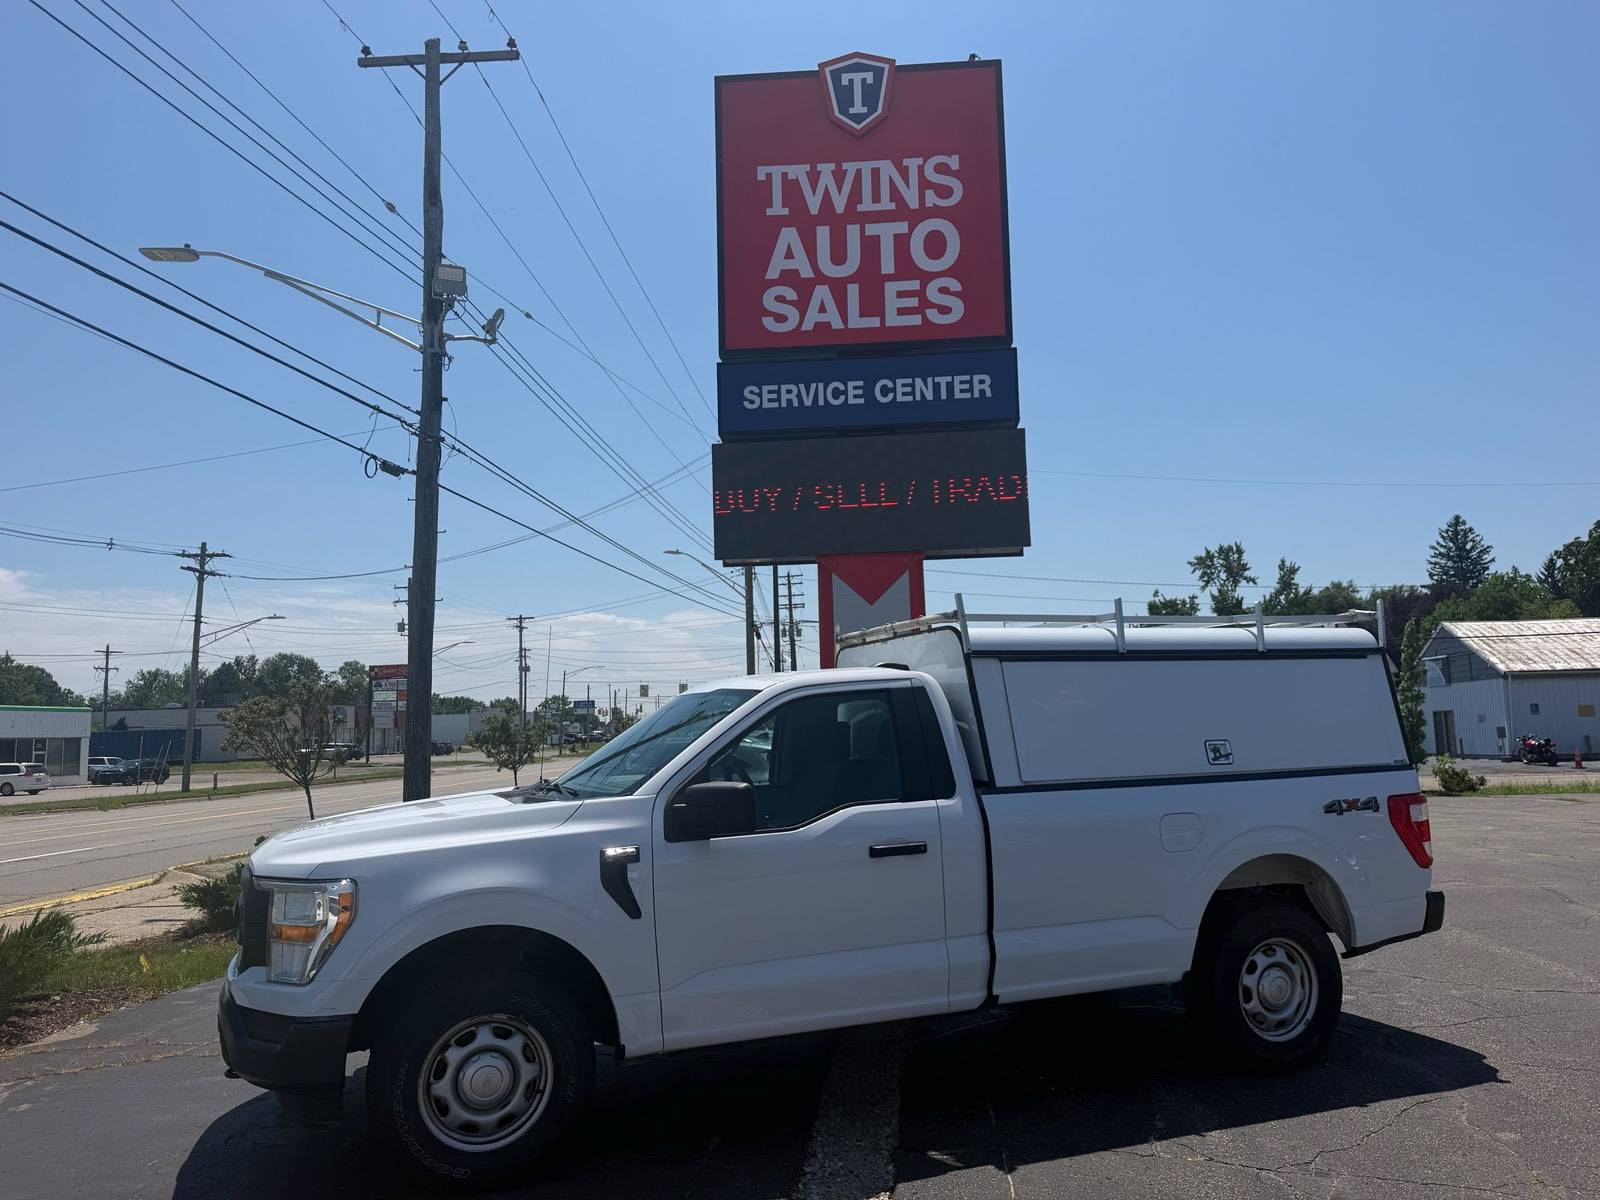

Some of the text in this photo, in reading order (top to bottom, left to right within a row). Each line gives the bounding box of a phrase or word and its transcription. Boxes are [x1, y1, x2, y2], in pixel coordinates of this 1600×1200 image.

[841, 71, 874, 114] T
[757, 154, 964, 216] TWINS
[764, 217, 961, 280] AUTO
[761, 276, 965, 333] SALES
[743, 373, 993, 410] SERVICE CENTER
[933, 475, 1029, 504] TRAD
